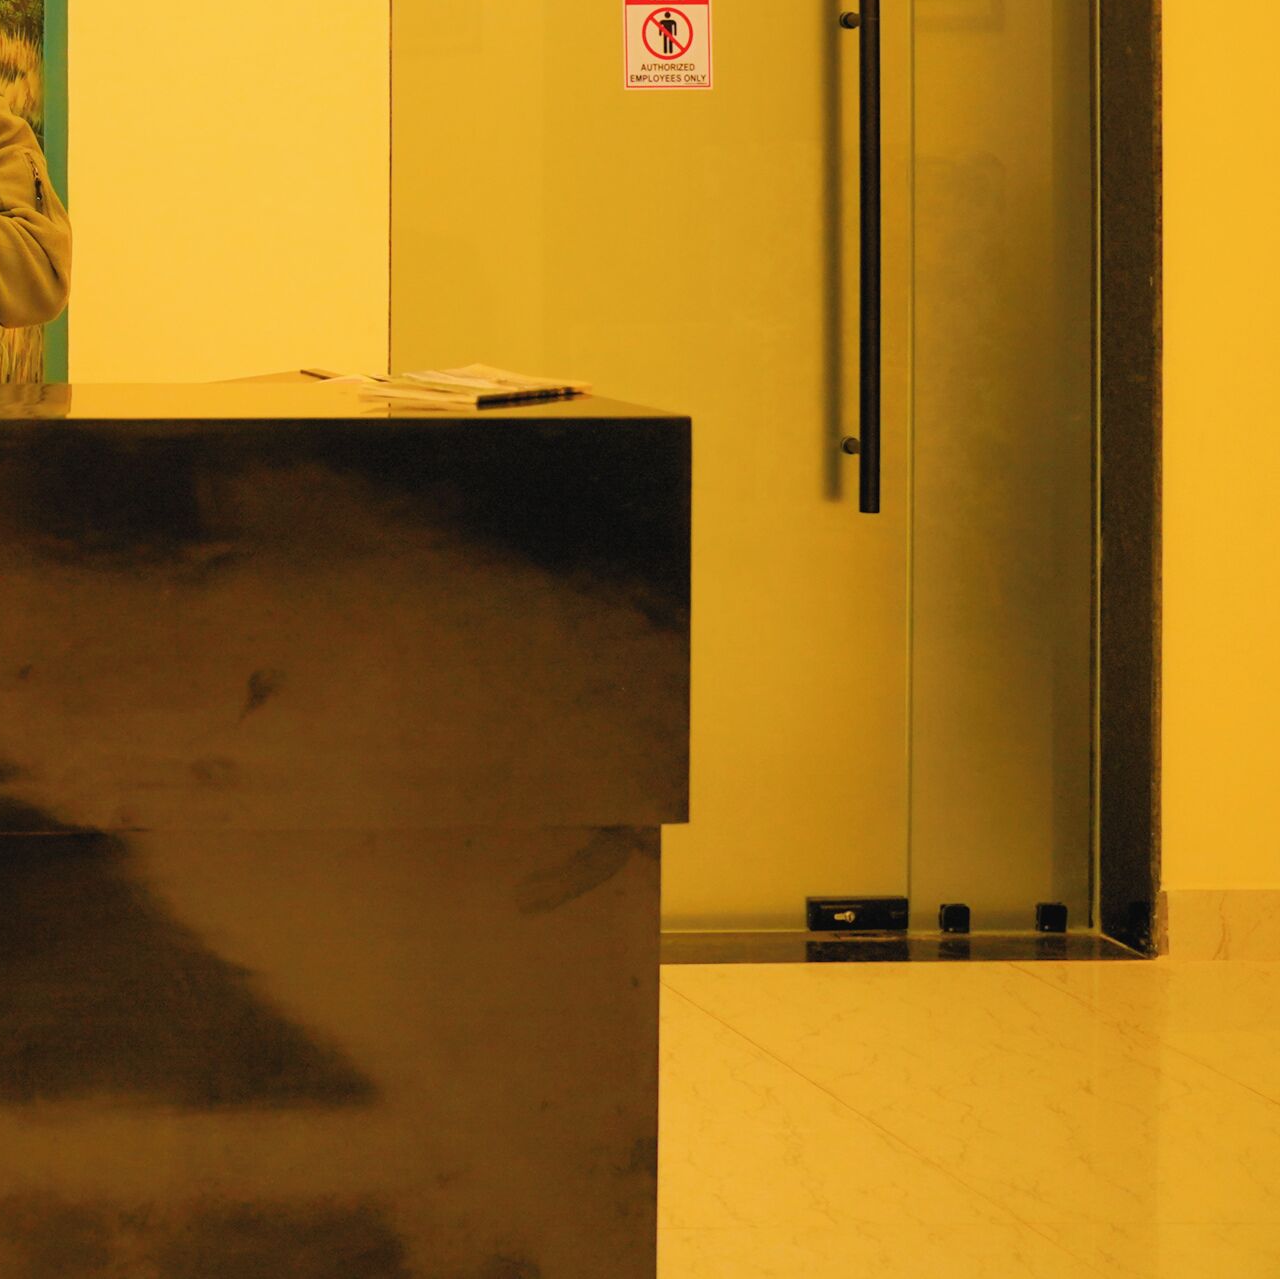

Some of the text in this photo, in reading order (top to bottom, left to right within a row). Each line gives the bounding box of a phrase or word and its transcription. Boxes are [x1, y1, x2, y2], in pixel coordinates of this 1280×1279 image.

[641, 63, 696, 72] AUTHORIZED
[630, 74, 707, 83] EMPLOYEES ONLY
